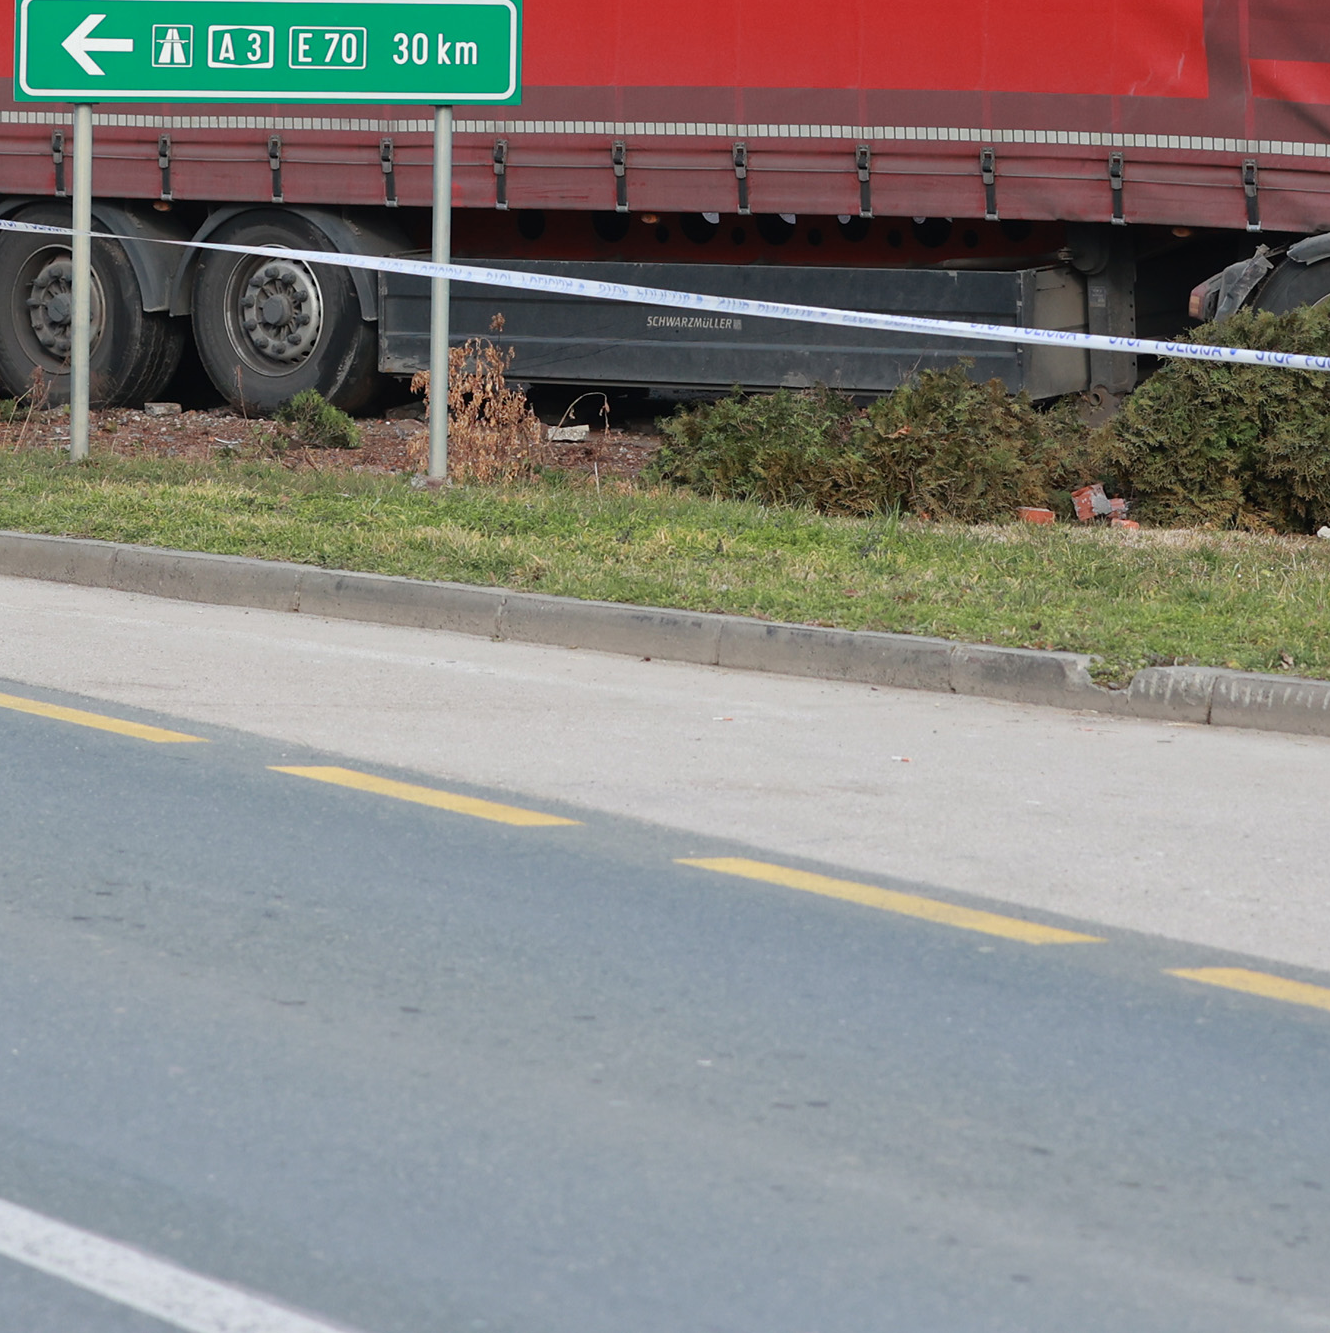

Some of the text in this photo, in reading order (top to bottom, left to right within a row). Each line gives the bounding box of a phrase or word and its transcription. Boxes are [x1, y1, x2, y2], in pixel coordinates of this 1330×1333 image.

[218, 32, 477, 65] A 3 E 70 30 km
